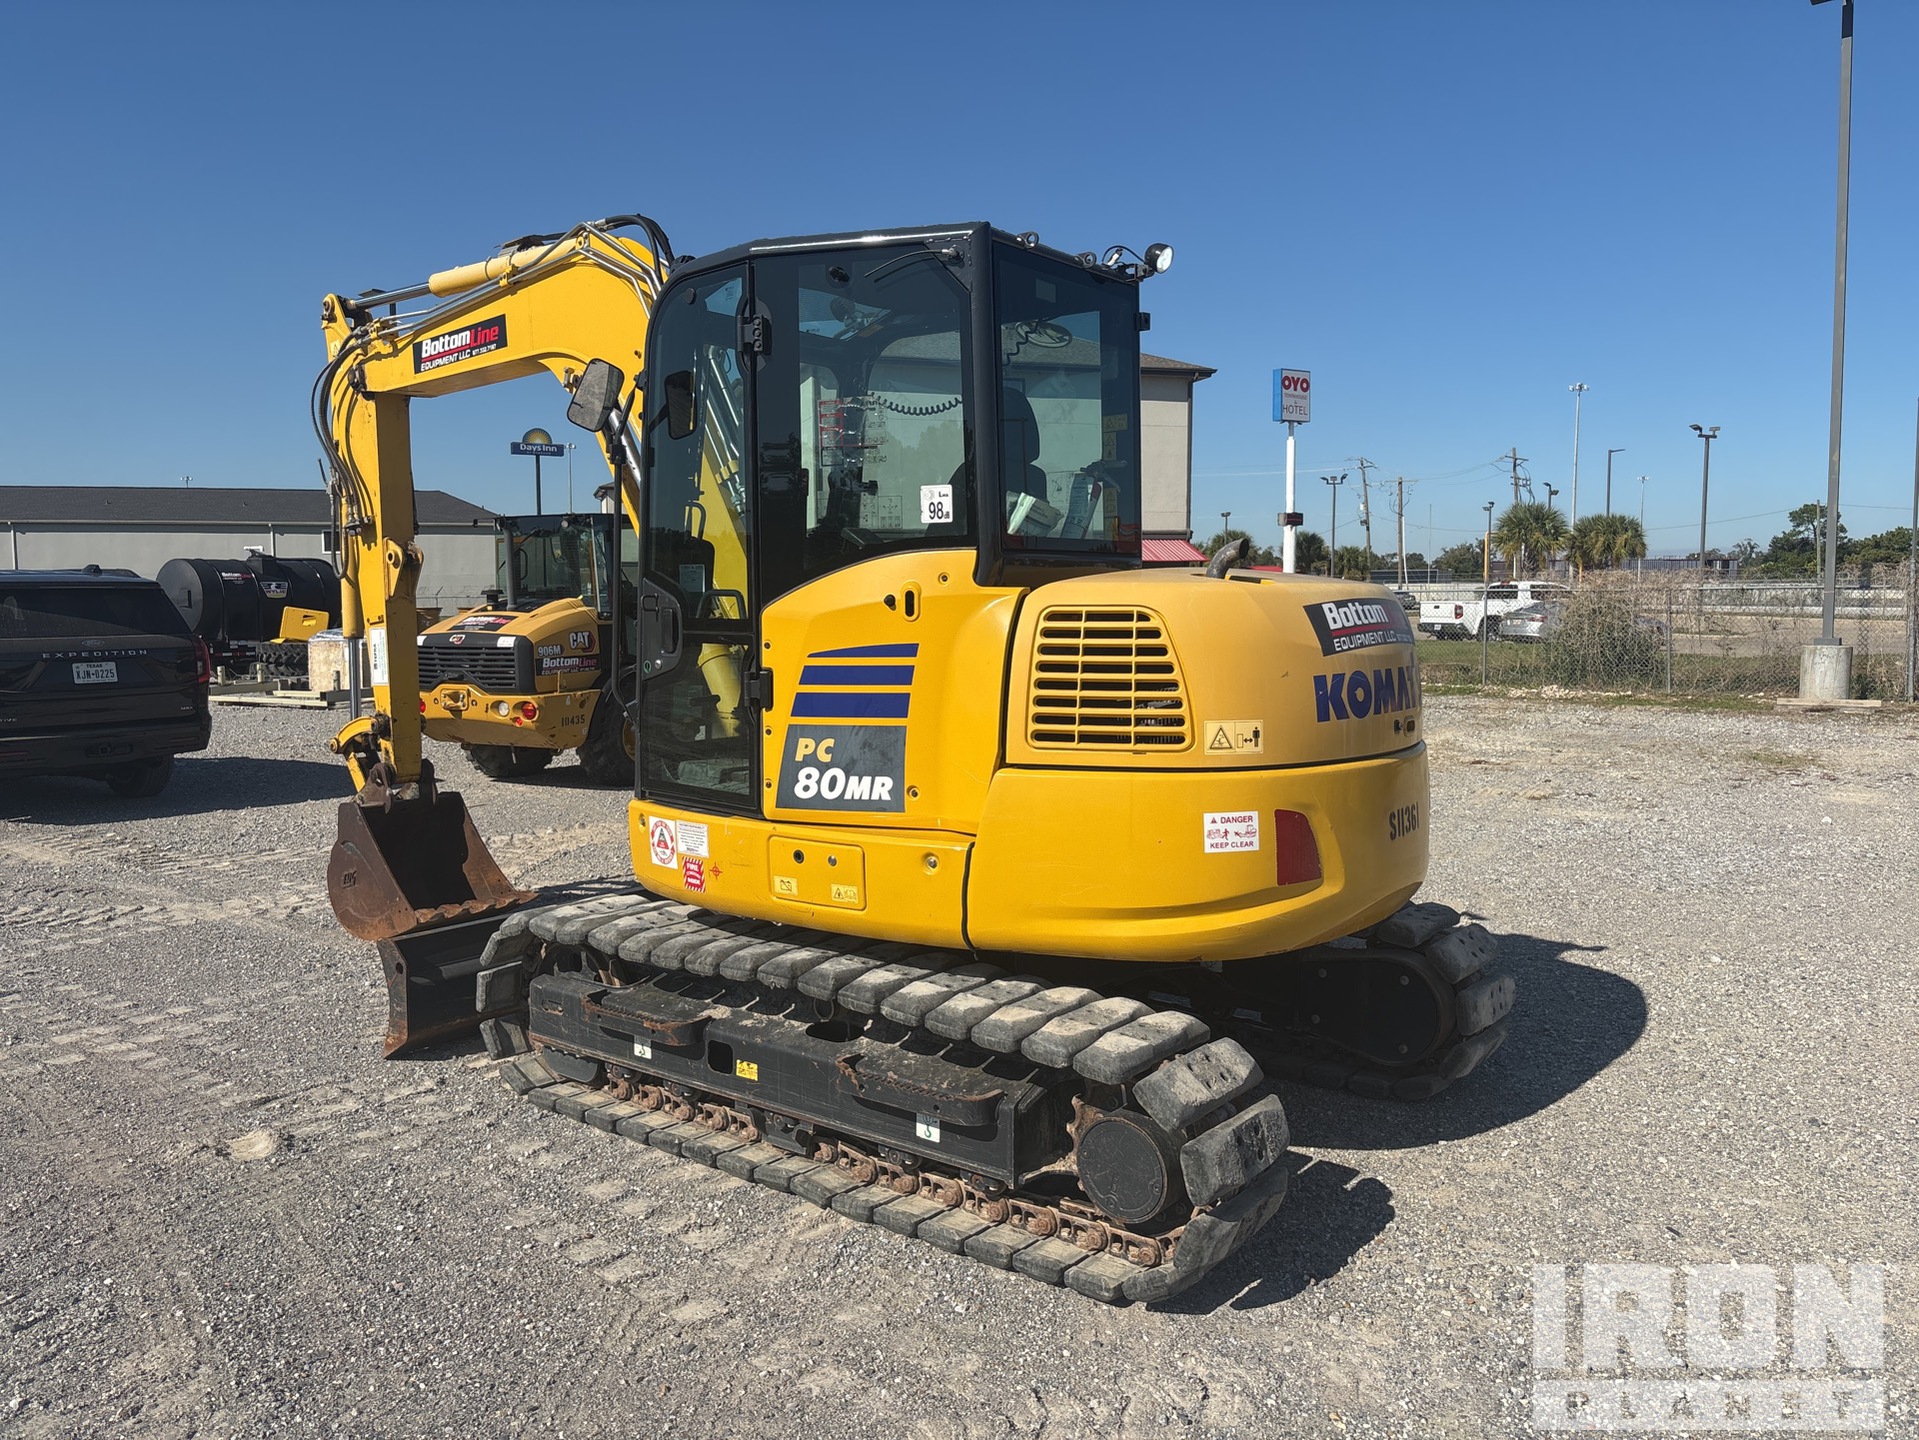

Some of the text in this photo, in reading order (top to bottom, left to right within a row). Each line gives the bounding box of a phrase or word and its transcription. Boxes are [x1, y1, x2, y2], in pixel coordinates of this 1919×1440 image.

[421, 325, 499, 358] BottomLine
[420, 353, 458, 371] EQUIPMENT
[459, 349, 471, 360] LLC
[1282, 375, 1310, 393] OYO
[1283, 404, 1308, 416] HOTEL
[520, 443, 542, 452] Days
[569, 631, 590, 649] CAT
[1333, 632, 1384, 652] EQUIPMENT
[1384, 630, 1397, 642] LLC
[42, 649, 148, 659] EXPEDITION
[538, 645, 561, 657] 906M
[795, 737, 835, 763] PC
[793, 766, 894, 801] 80MR
[1220, 815, 1253, 824] DANGER
[1210, 840, 1254, 849] KEEP CLEAR
